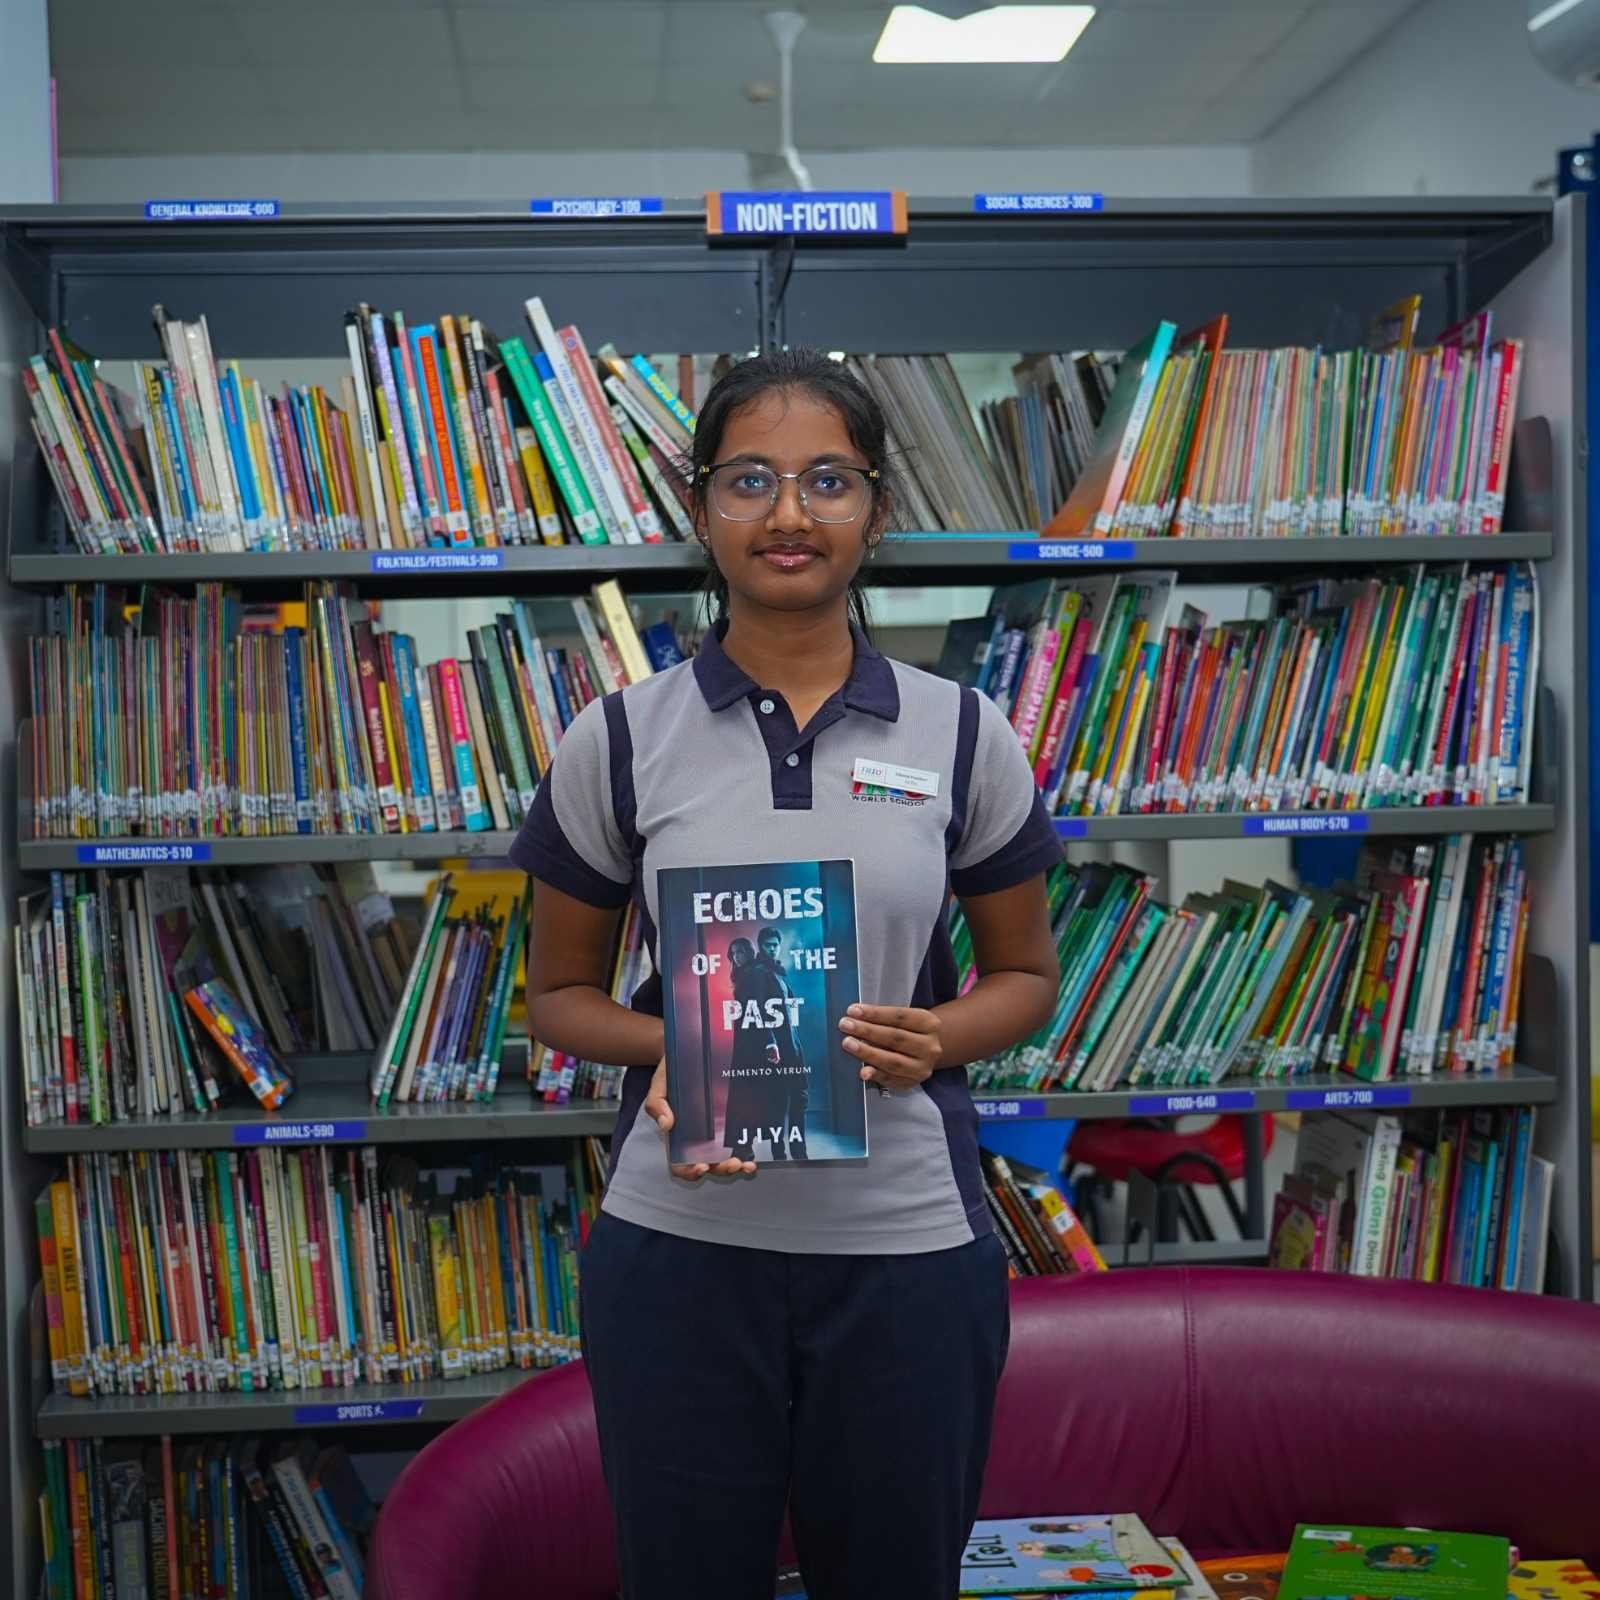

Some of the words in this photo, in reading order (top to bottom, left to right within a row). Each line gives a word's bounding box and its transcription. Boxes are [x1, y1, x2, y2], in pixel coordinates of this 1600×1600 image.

[984, 196, 1020, 209] SOCIAL
[150, 204, 192, 217] GENERAL
[736, 202, 877, 232] NON-FICTION
[1038, 545, 1104, 558] SCIENCE-500
[852, 795, 887, 803] WORLD
[1263, 818, 1299, 831] HUMAN
[1300, 816, 1349, 830] BODY-570
[96, 847, 192, 860] MATHEMATICS-510
[693, 887, 823, 923] ECHOES
[691, 953, 721, 975] OF
[790, 948, 837, 969] THE
[723, 998, 804, 1030] PAST
[722, 1067, 771, 1077] MEMENTO
[776, 1066, 811, 1074] VERUM
[1167, 1096, 1216, 1110] FOOD-640
[1325, 1091, 1374, 1104] ARTS-700
[264, 1125, 334, 1139] ANIMALS-590
[737, 1126, 803, 1145] JIYA
[1368, 1186, 1387, 1235] Giant
